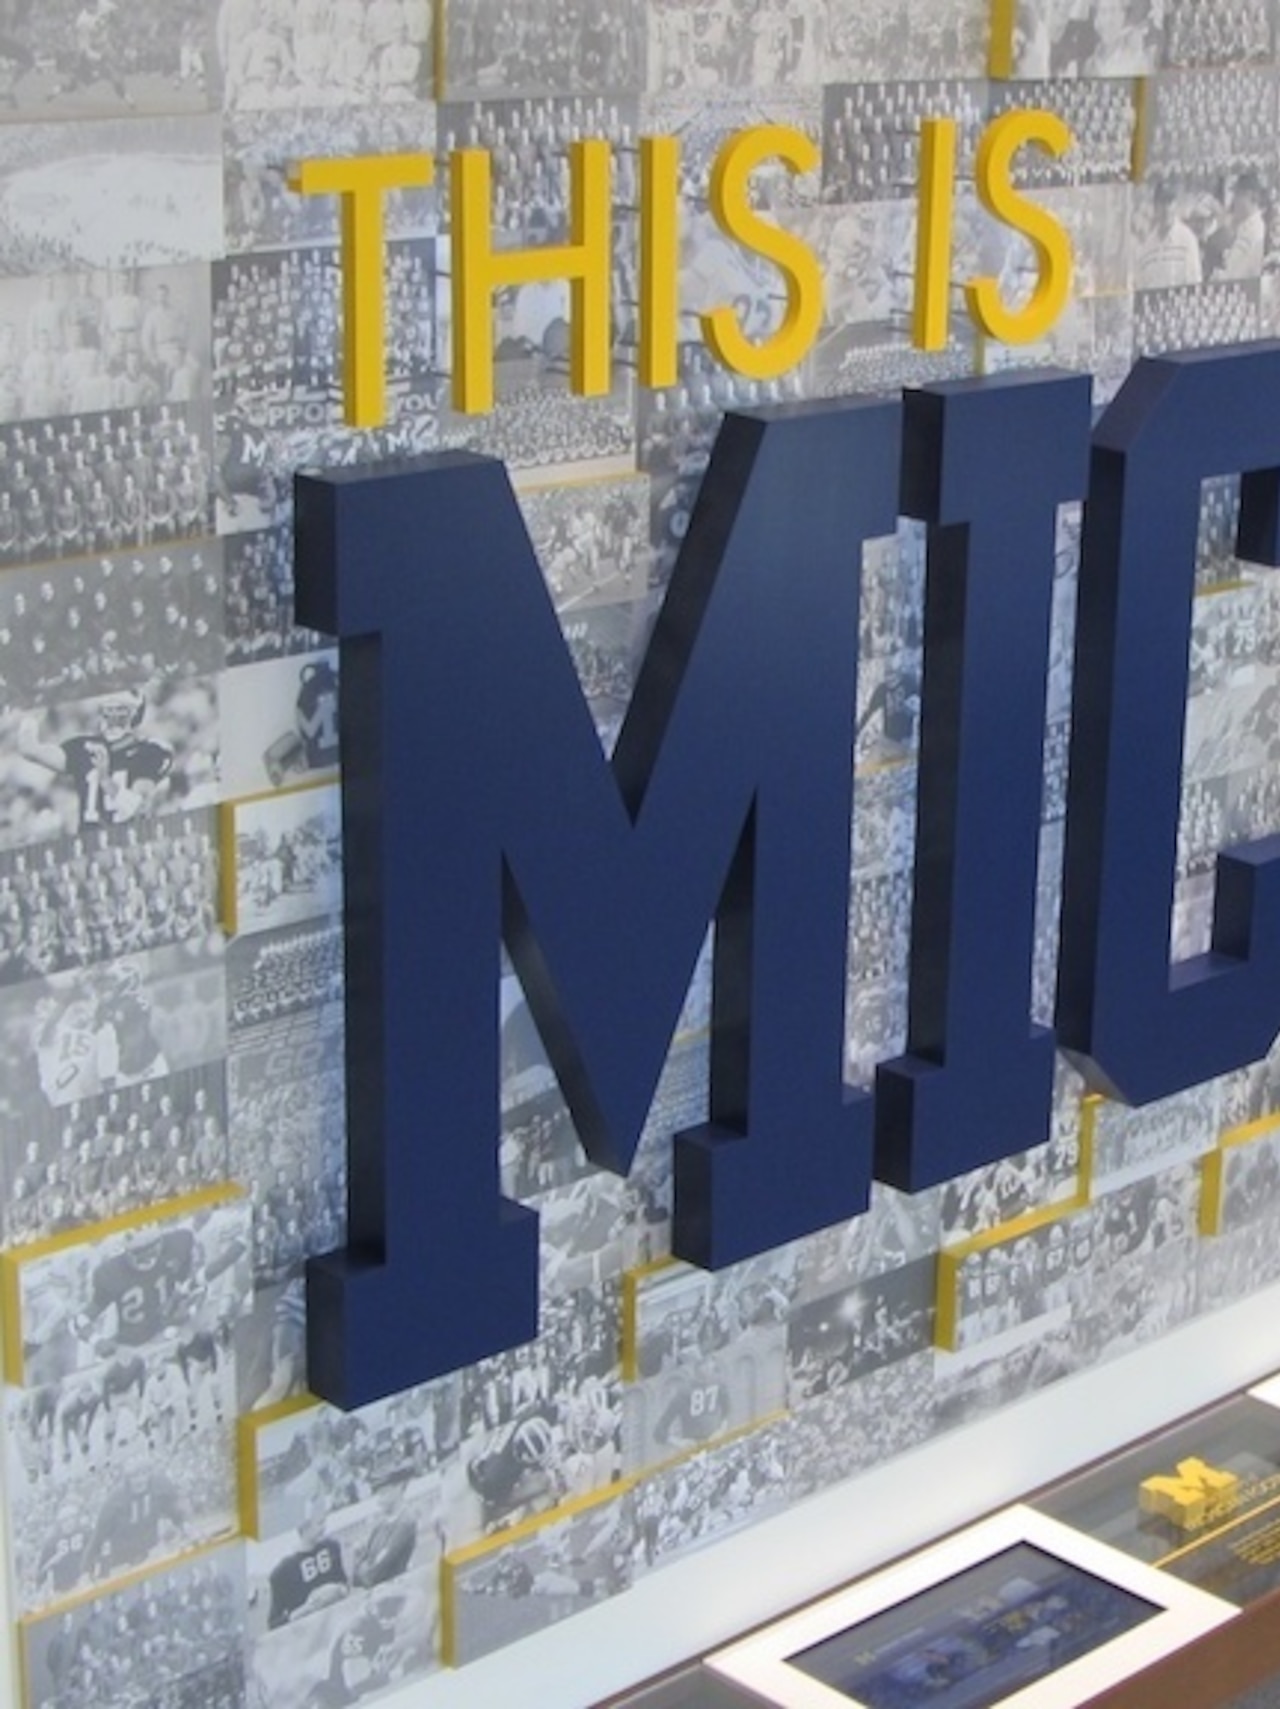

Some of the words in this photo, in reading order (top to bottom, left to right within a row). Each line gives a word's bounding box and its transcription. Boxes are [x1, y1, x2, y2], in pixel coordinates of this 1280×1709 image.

[286, 122, 824, 430] THIS
[910, 107, 1076, 353] IS
[690, 1384, 719, 1417] 87
[300, 1548, 331, 1583] 66
